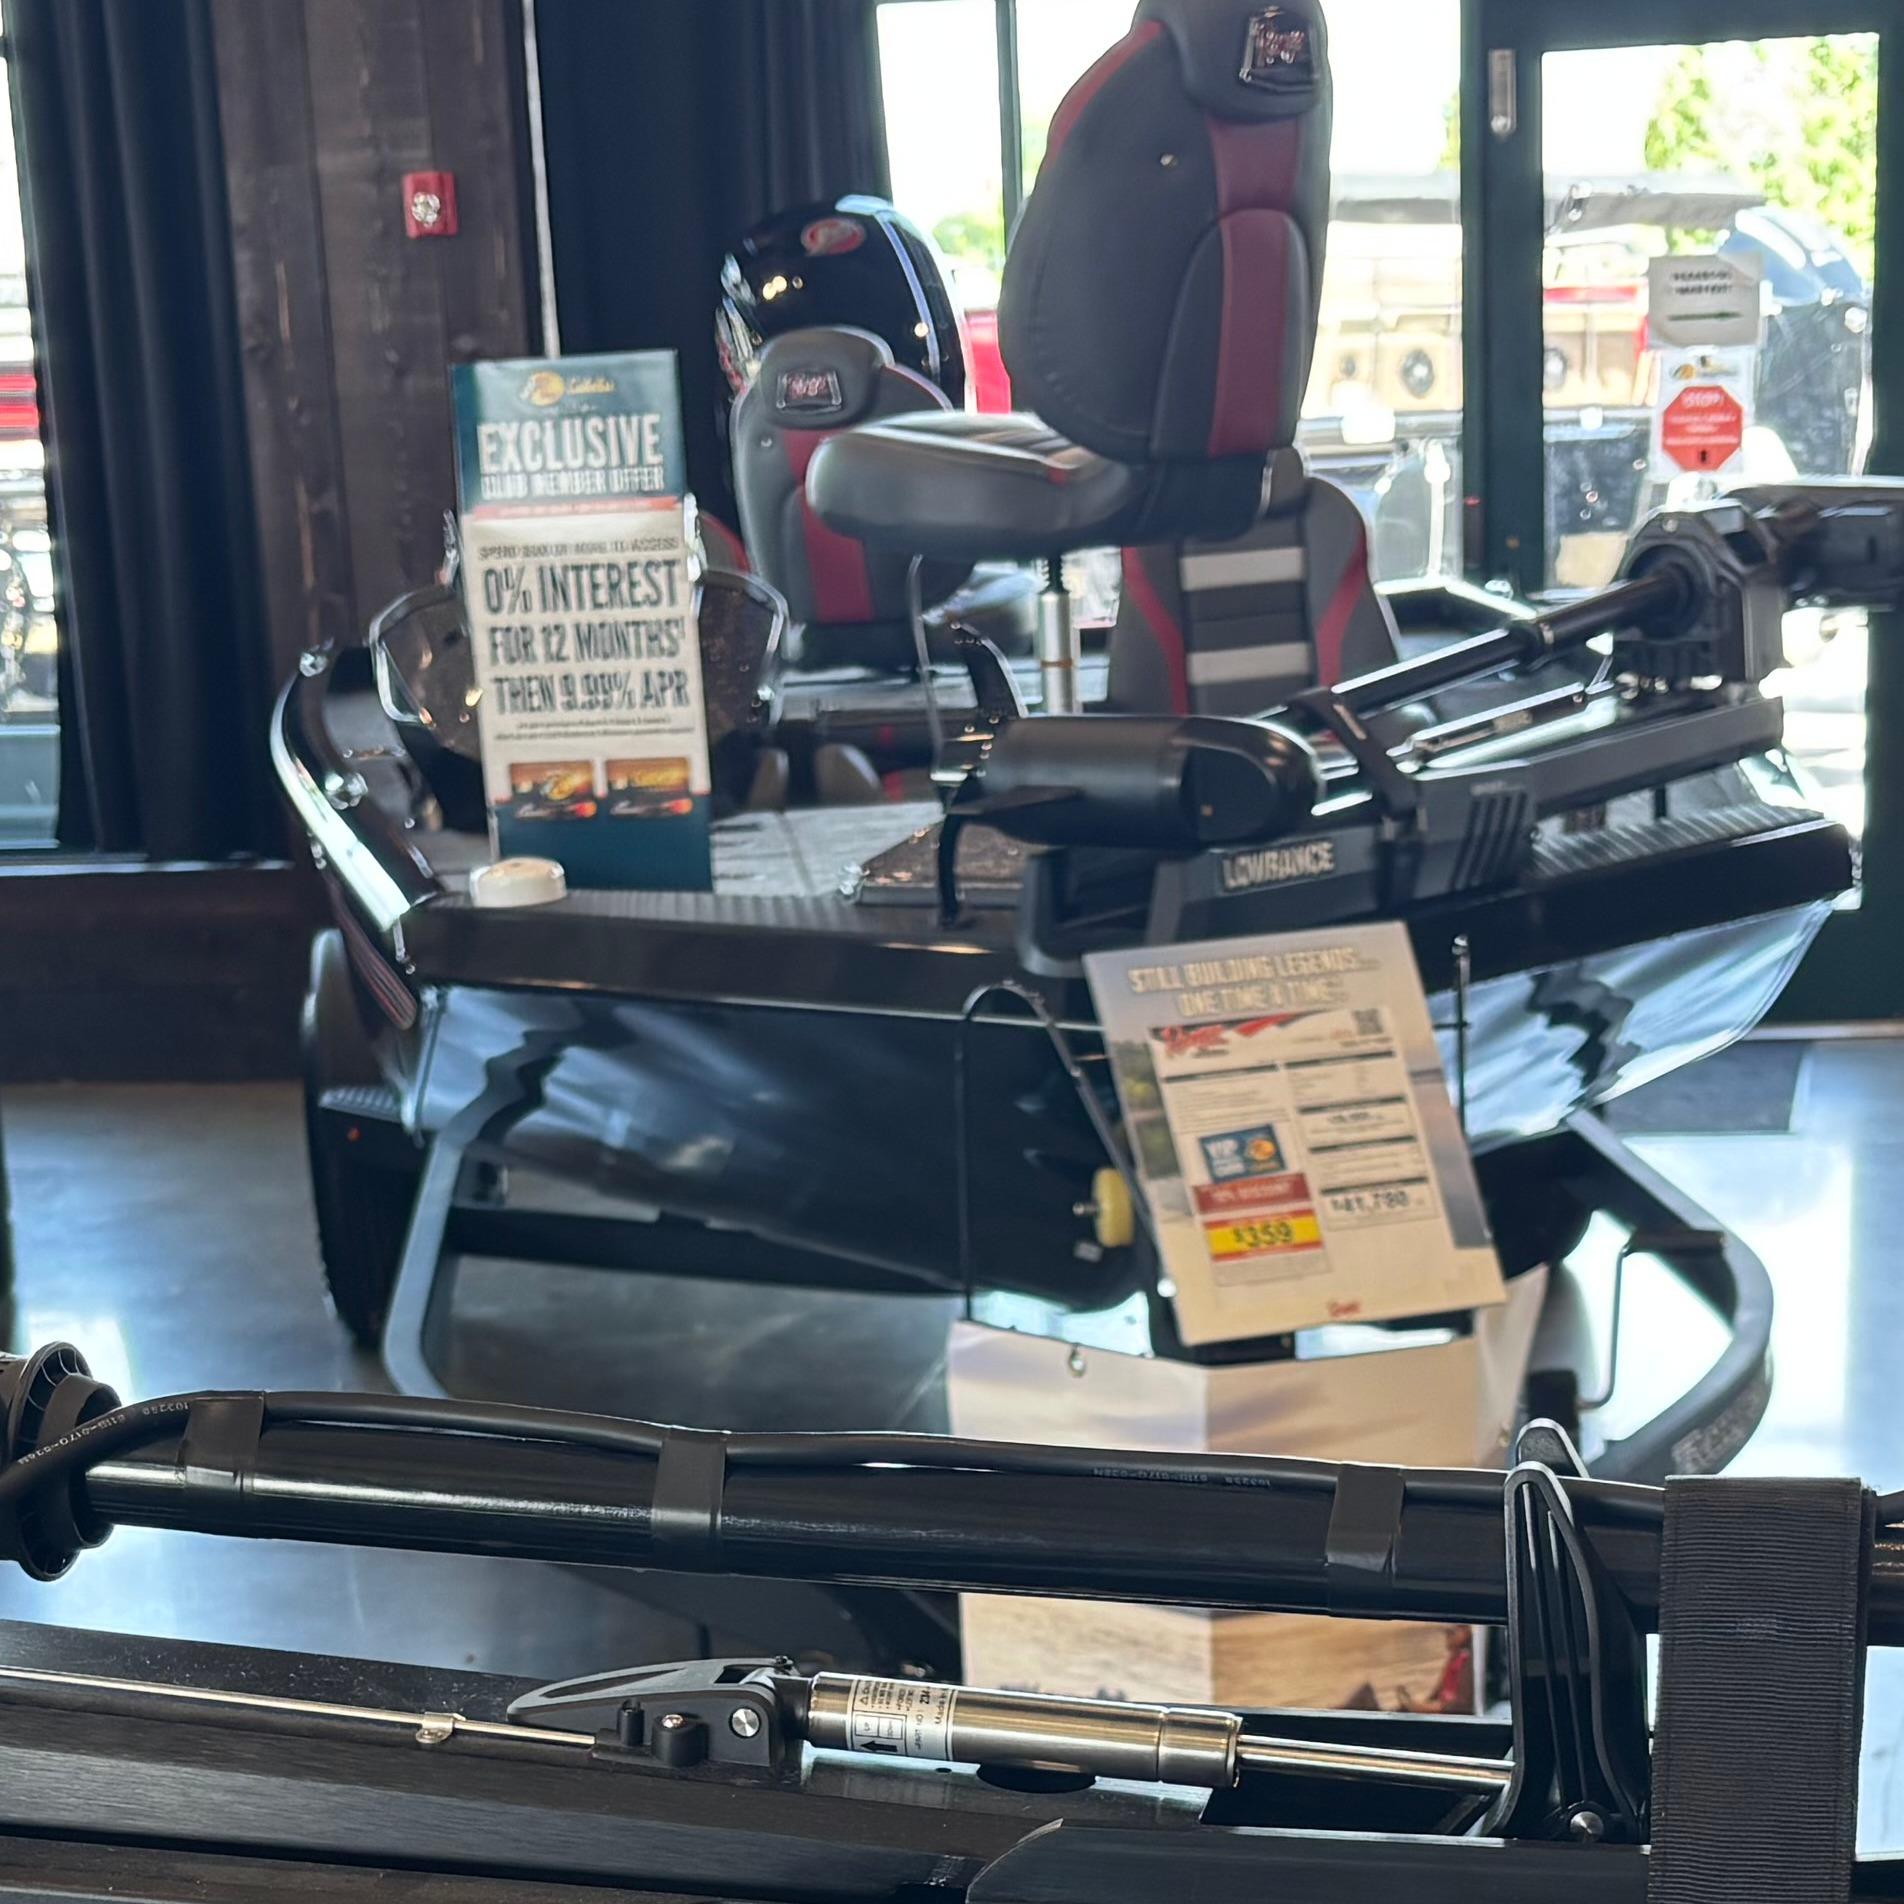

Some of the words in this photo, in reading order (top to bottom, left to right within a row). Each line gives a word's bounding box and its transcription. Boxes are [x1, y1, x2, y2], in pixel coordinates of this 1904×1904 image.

[477, 412, 663, 474] EXCLUSIVE
[484, 565, 532, 615] 0%
[538, 559, 680, 612] INTEREST
[490, 624, 538, 666] FOR
[542, 623, 570, 662] 12
[493, 674, 556, 715] THEN
[560, 670, 637, 711] 9.99%
[640, 669, 690, 708] APR
[1222, 842, 1335, 889] LOWRANCE
[1233, 1221, 1293, 1248] $359
